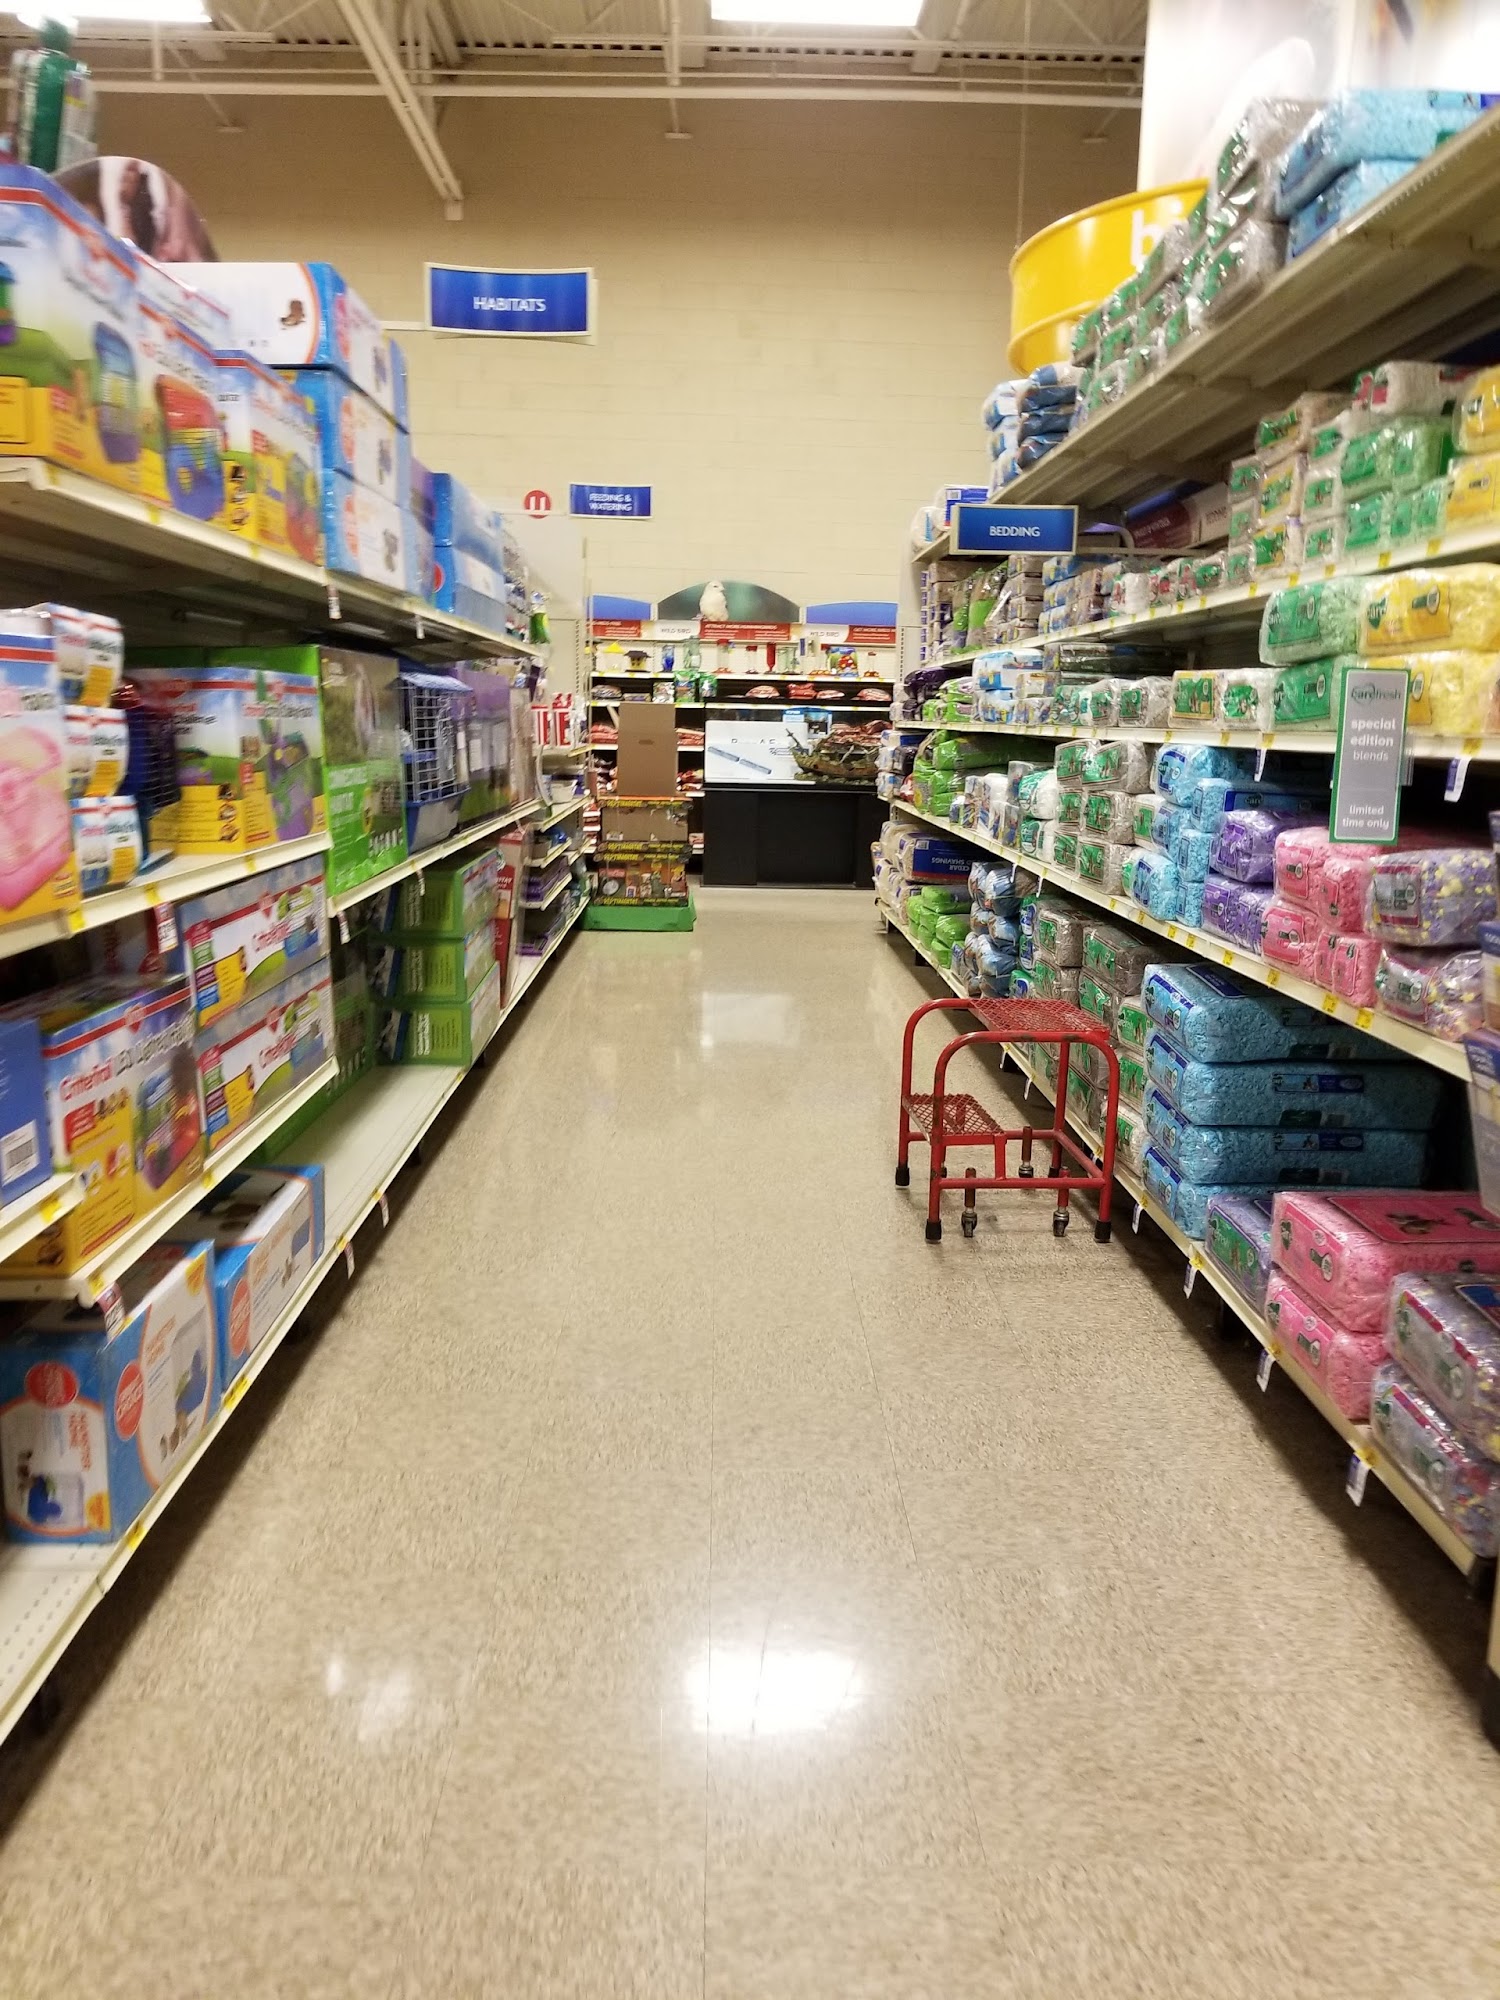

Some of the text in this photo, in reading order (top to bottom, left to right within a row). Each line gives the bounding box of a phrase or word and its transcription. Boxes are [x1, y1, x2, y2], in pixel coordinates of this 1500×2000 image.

[473, 296, 547, 312] HABITATS
[589, 493, 624, 503] FEEDING
[589, 502, 632, 511] WATERING
[989, 526, 1041, 537] BEDDING
[1351, 718, 1396, 732] special
[1350, 734, 1394, 747] edition
[1353, 751, 1389, 762] blends
[1349, 805, 1385, 816] limited
[1342, 817, 1390, 831] time only
[931, 856, 965, 865] SHAVINGS
